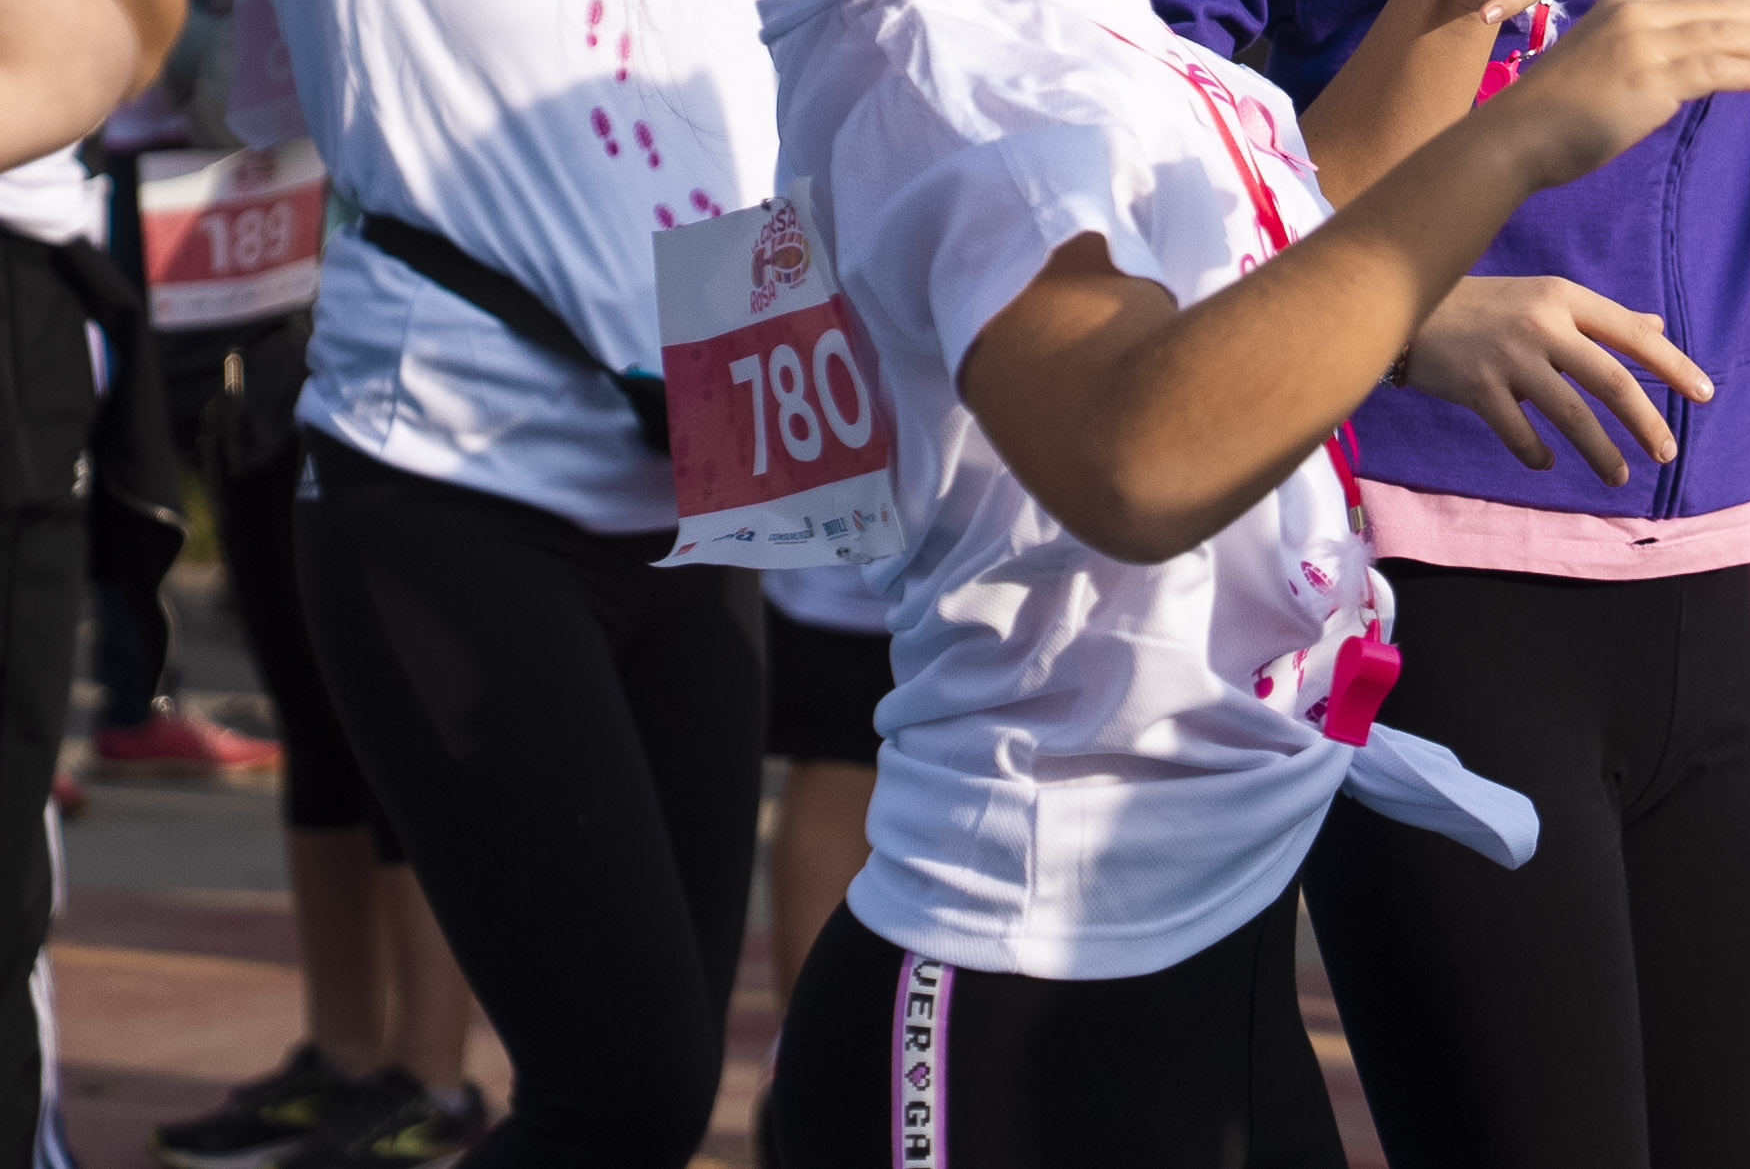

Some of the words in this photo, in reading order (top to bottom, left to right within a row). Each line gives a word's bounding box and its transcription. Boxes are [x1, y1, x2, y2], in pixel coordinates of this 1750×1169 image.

[203, 199, 296, 272] 189
[728, 328, 872, 477] 780
[904, 960, 941, 1052] VER
[904, 1100, 932, 1169] GA
